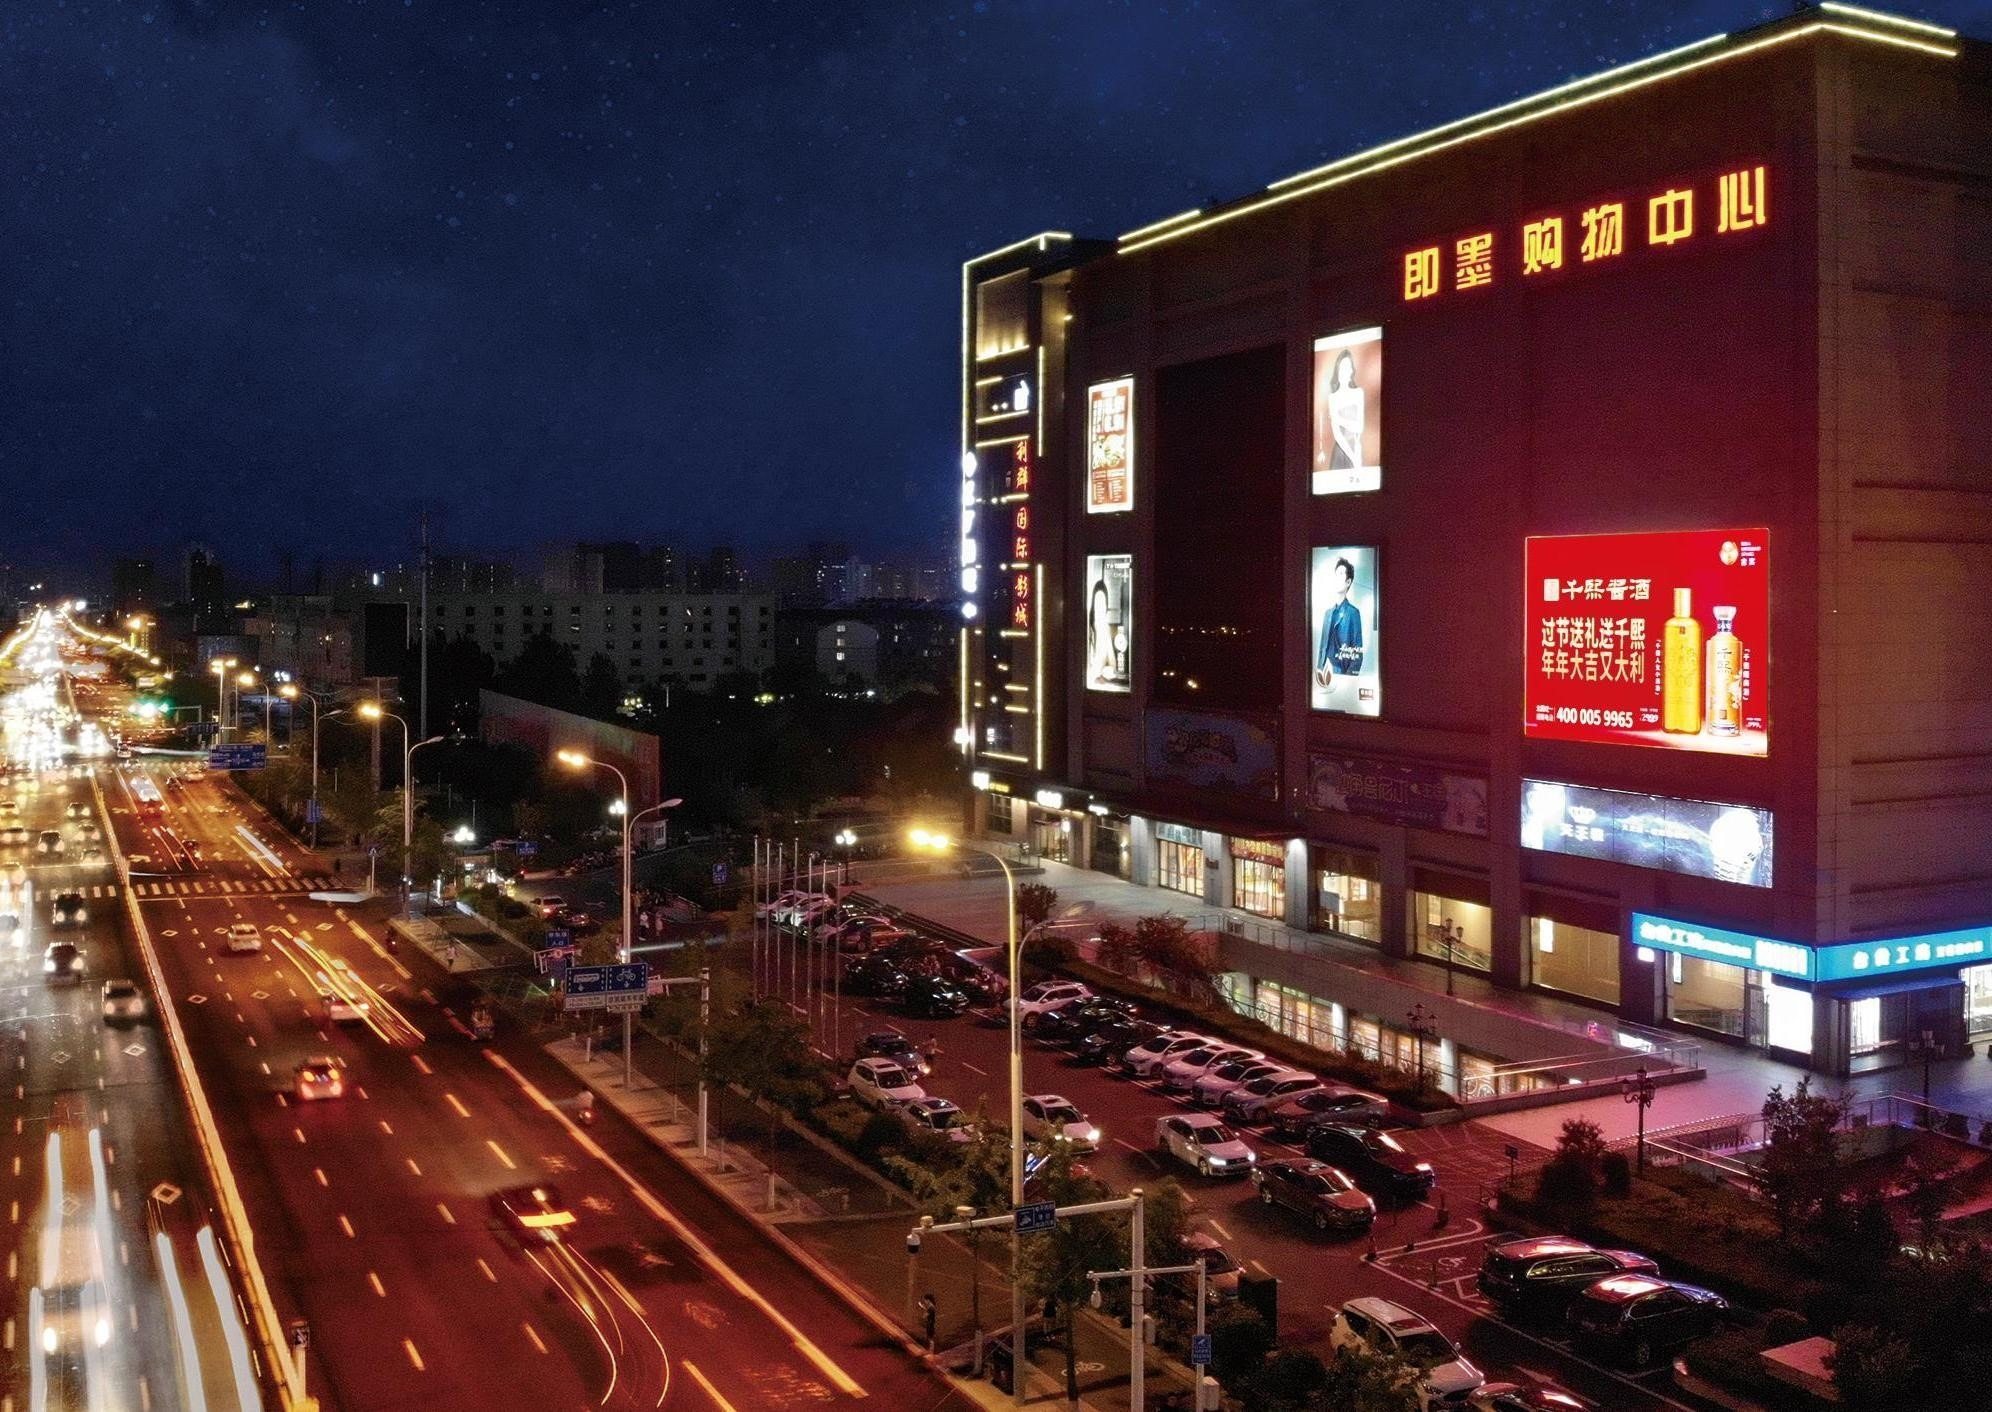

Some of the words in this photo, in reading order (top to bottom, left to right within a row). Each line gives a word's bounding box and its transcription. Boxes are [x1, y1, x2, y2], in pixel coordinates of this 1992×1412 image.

[1404, 166, 1766, 301] 即墨购物中心
[1541, 617, 1645, 649] 过节送礼送千熙
[1541, 649, 1645, 683] 年年大吉又大利
[1556, 706, 1578, 724] 400
[1579, 707, 1601, 726] 005
[1603, 709, 1634, 729] 9965
